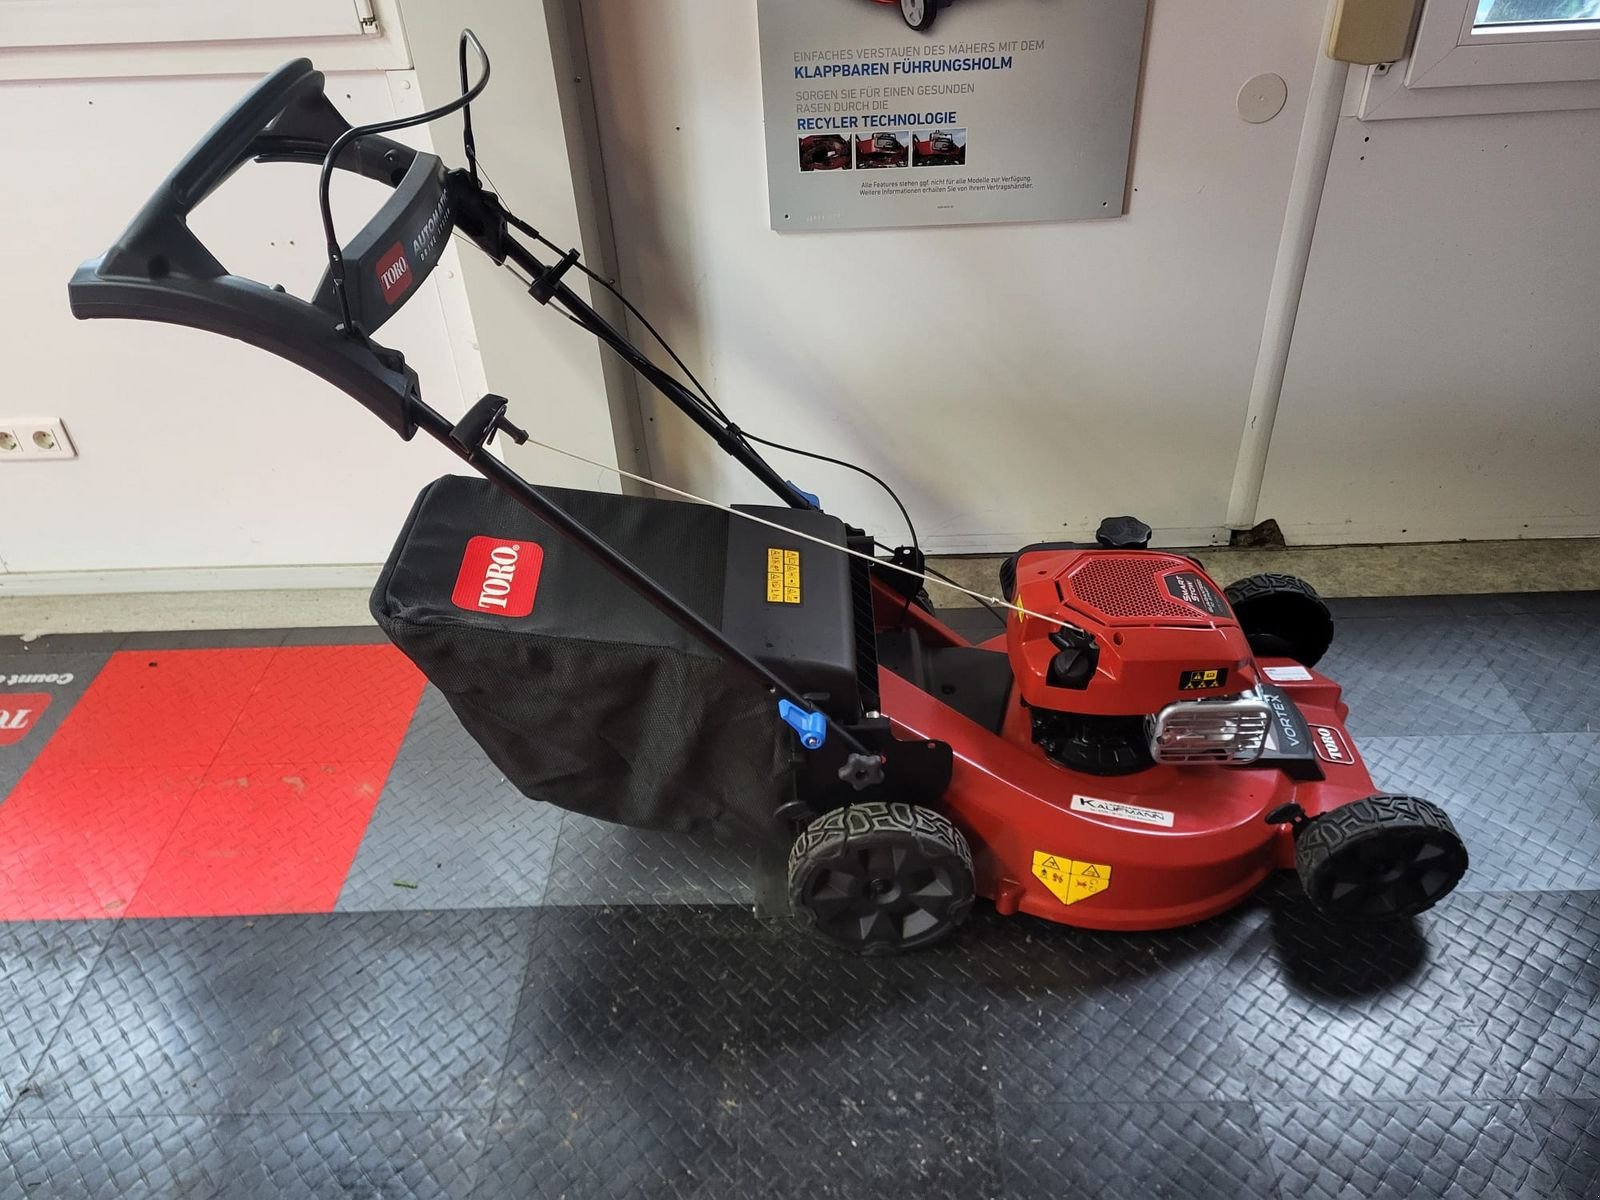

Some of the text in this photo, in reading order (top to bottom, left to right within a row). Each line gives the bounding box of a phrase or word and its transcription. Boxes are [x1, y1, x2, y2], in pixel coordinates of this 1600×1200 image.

[793, 39, 1046, 62] EINFACHES VERSTAUEN DES MÄHERS MIT DEM
[794, 56, 1013, 79] KLAPPBAREN FÜHRUNGSHOLM
[795, 83, 975, 101] SORGEN SIE FÜR EINEN GESUNDEN
[796, 100, 889, 113] RASEN DURCH DIE
[797, 111, 957, 130] RECYLER TECHNOLOGIE
[967, 176, 990, 184] Modelle
[860, 188, 880, 196] Weitere
[881, 187, 922, 195] Informationen
[922, 185, 947, 193] erhalten
[381, 256, 408, 290] TORO
[7, 672, 74, 686] Count
[1272, 694, 1300, 747] VORTEX
[1317, 727, 1342, 760] TORO
